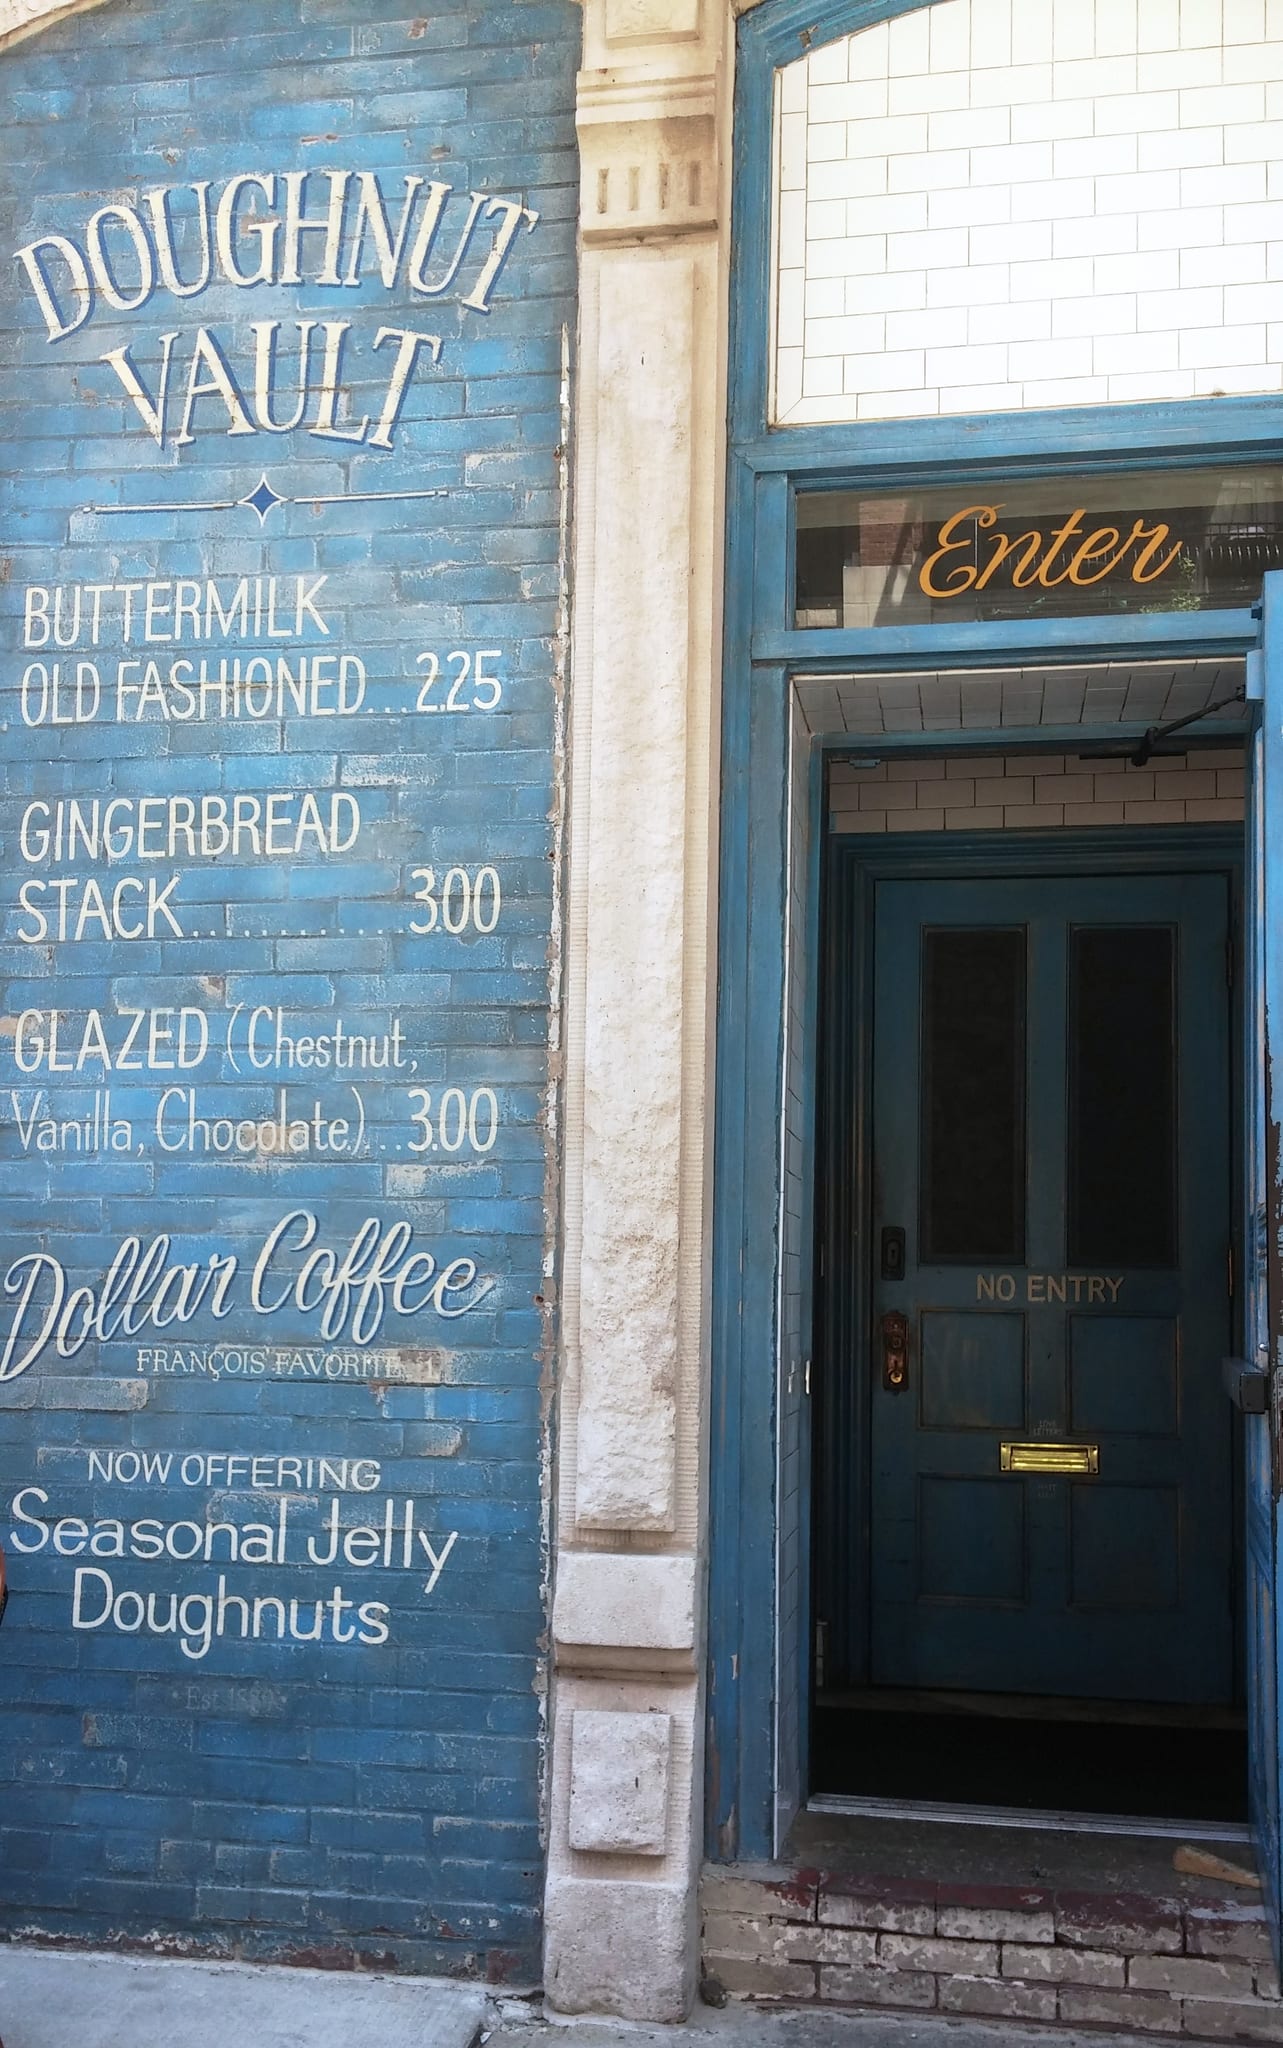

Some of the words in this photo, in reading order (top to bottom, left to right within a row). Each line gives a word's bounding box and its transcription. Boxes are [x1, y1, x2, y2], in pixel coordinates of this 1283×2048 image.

[13, 170, 540, 344] DOUGHNUT
[100, 321, 443, 451] VAULT
[919, 503, 1183, 598] Enter
[23, 575, 330, 648] BUTTERMILK
[21, 662, 101, 727] OLD
[116, 655, 366, 720] FASHIONED
[19, 792, 361, 863] GINGERBREAD
[17, 872, 184, 943] STACK
[14, 1007, 209, 1072] GLAZED
[227, 1003, 418, 1074] (Chestnut,
[8, 1090, 144, 1157] Vanilla,
[408, 1087, 499, 1152] 3.00
[0, 1233, 237, 1381] Dollar
[251, 1209, 495, 1345] Coffee
[976, 1273, 1016, 1301] NO
[1026, 1274, 1125, 1303] ENTRY
[88, 1451, 172, 1484] NOW
[181, 1454, 381, 1491] OFFERING
[10, 1487, 287, 1565] Seasonal
[308, 1498, 458, 1594] Jelly
[72, 1567, 390, 1660] Doughnuts
